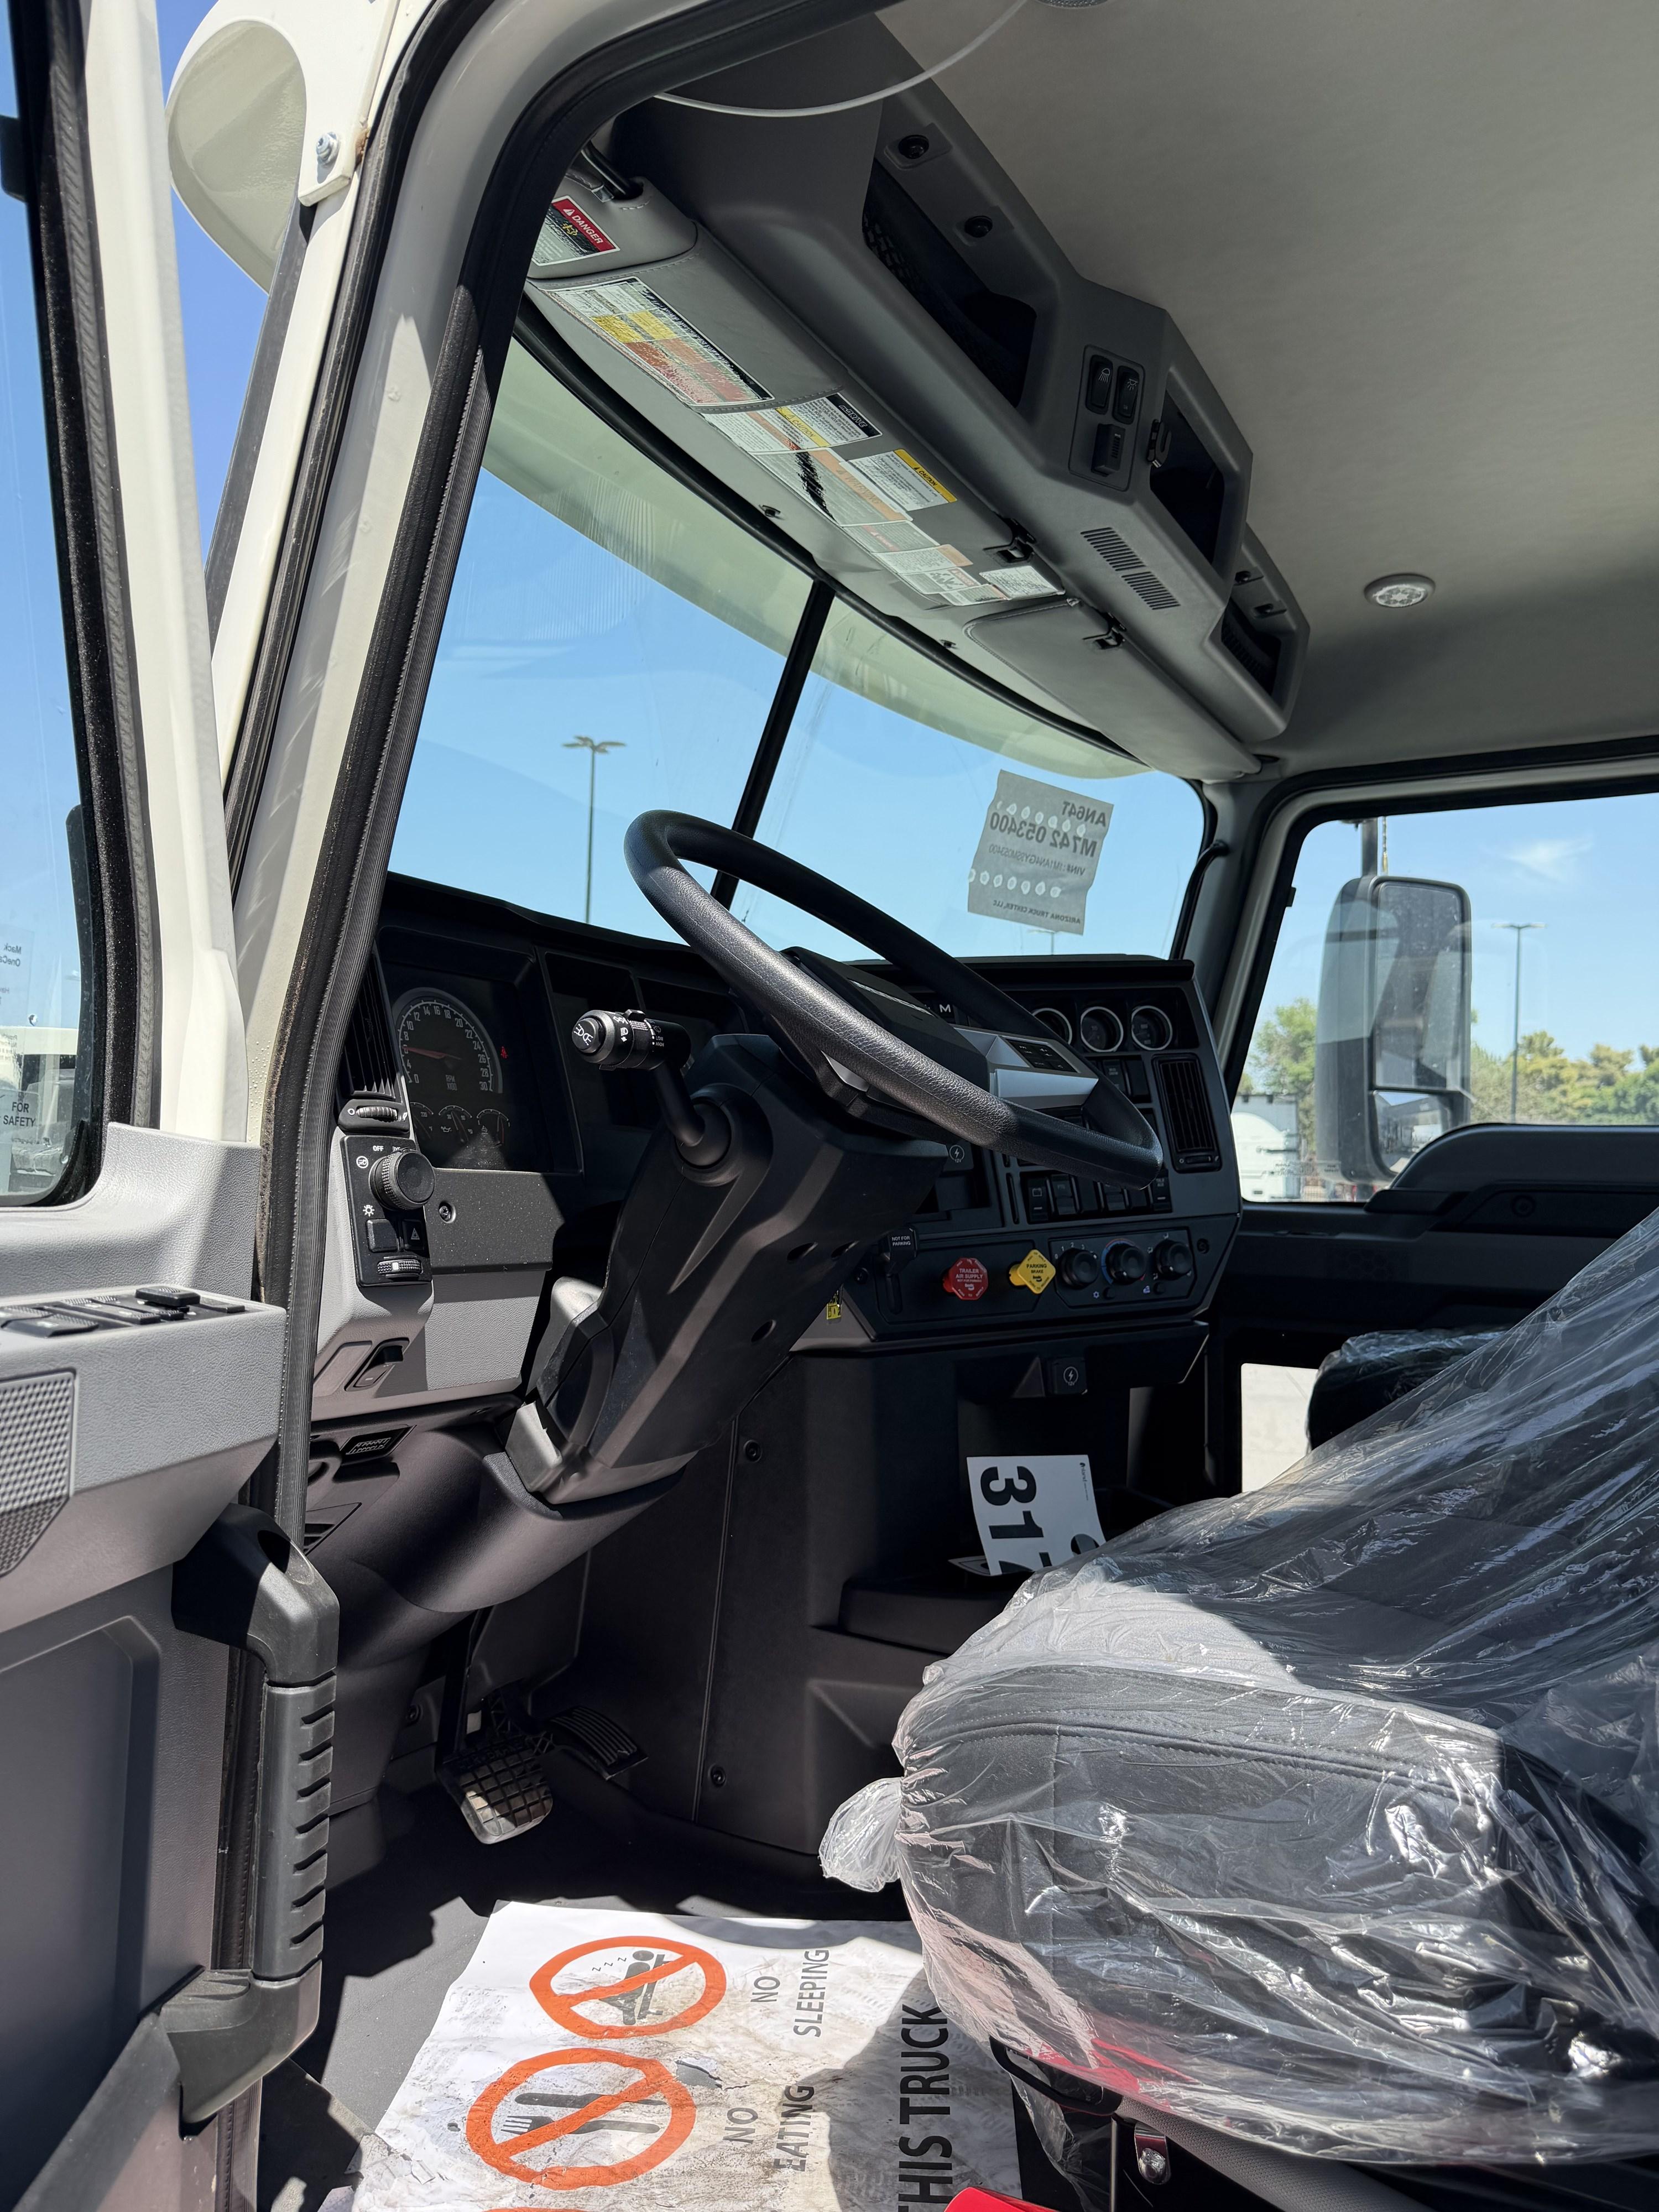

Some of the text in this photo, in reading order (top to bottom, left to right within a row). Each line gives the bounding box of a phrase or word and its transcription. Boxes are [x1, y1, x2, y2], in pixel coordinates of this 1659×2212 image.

[572, 215, 603, 243] DANGER
[792, 420, 816, 437] CAUTION
[919, 470, 938, 487] CAUTION
[845, 476, 883, 504] WARNING
[423, 1006, 430, 1016] 14
[434, 1005, 441, 1015] 16
[940, 1004, 951, 1013] M
[414, 1012, 421, 1021] 12
[444, 1009, 451, 1019] 18
[406, 1020, 414, 1031] 10
[455, 1018, 463, 1027] 20
[403, 1031, 409, 1041] 8
[465, 1029, 474, 1039] 22
[473, 1041, 481, 1050] 24
[478, 1054, 486, 1063] 26
[406, 1059, 412, 1069] 4
[480, 1068, 489, 1077] 28
[414, 1074, 420, 1084] 0
[479, 1081, 488, 1091] 30
[12, 1102, 29, 1113] FOR
[3, 1115, 36, 1127] SAFETY
[750, 1976, 780, 2003] NO
[793, 1950, 830, 2037] SLEEPING
[898, 2004, 953, 2212] HIS TRUCK
[723, 2107, 759, 2144] NO
[775, 2085, 815, 2172] EATING
